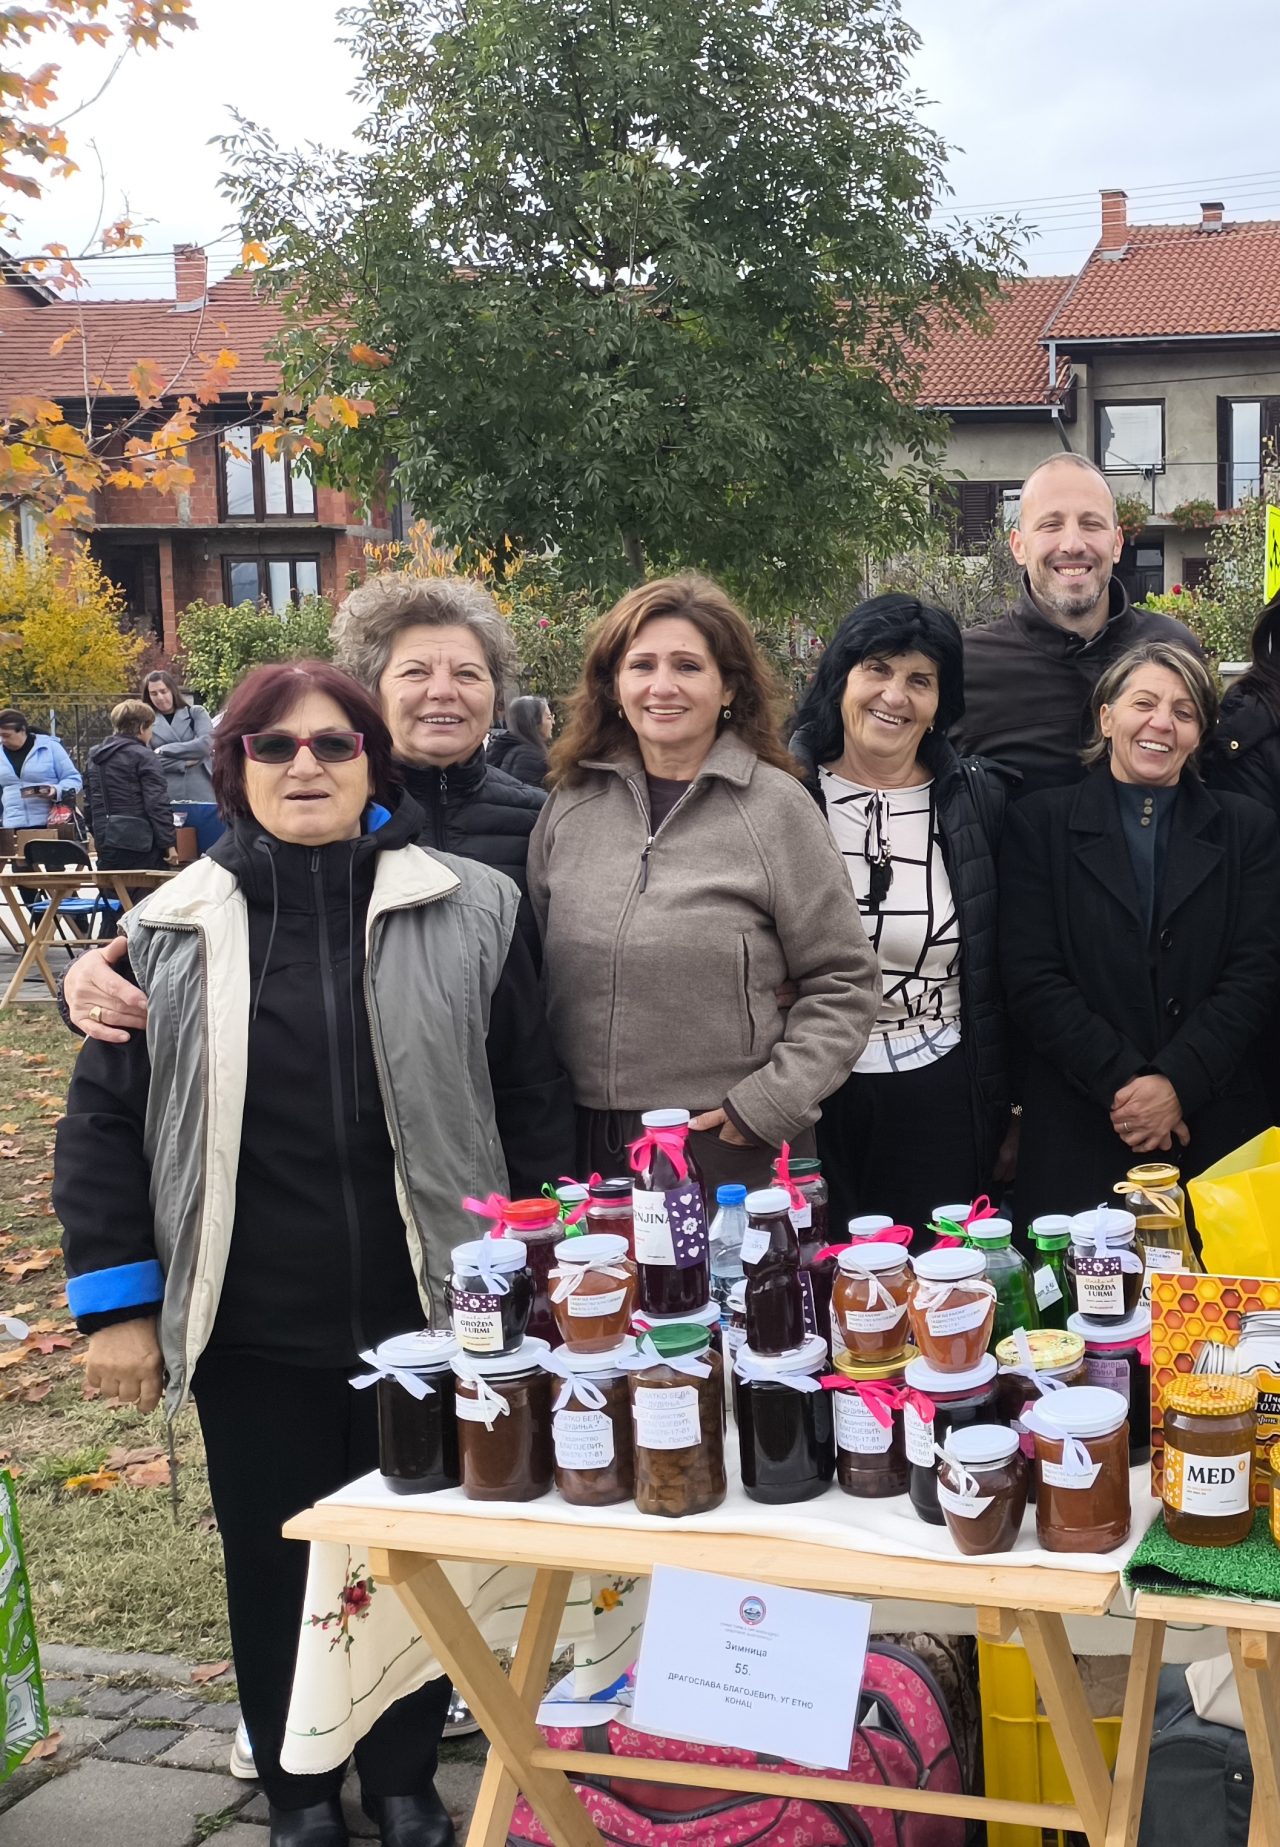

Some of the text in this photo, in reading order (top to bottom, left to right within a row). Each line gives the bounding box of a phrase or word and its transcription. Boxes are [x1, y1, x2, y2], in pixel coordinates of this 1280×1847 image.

[1187, 1465, 1236, 1485] MED
[725, 1640, 767, 1657] Зимница
[735, 1662, 751, 1676] 55.
[668, 1672, 721, 1689] ДРАГОСЛАВА
[792, 1698, 813, 1709] ЕТНО
[725, 1696, 752, 1709] КОНАЦ
